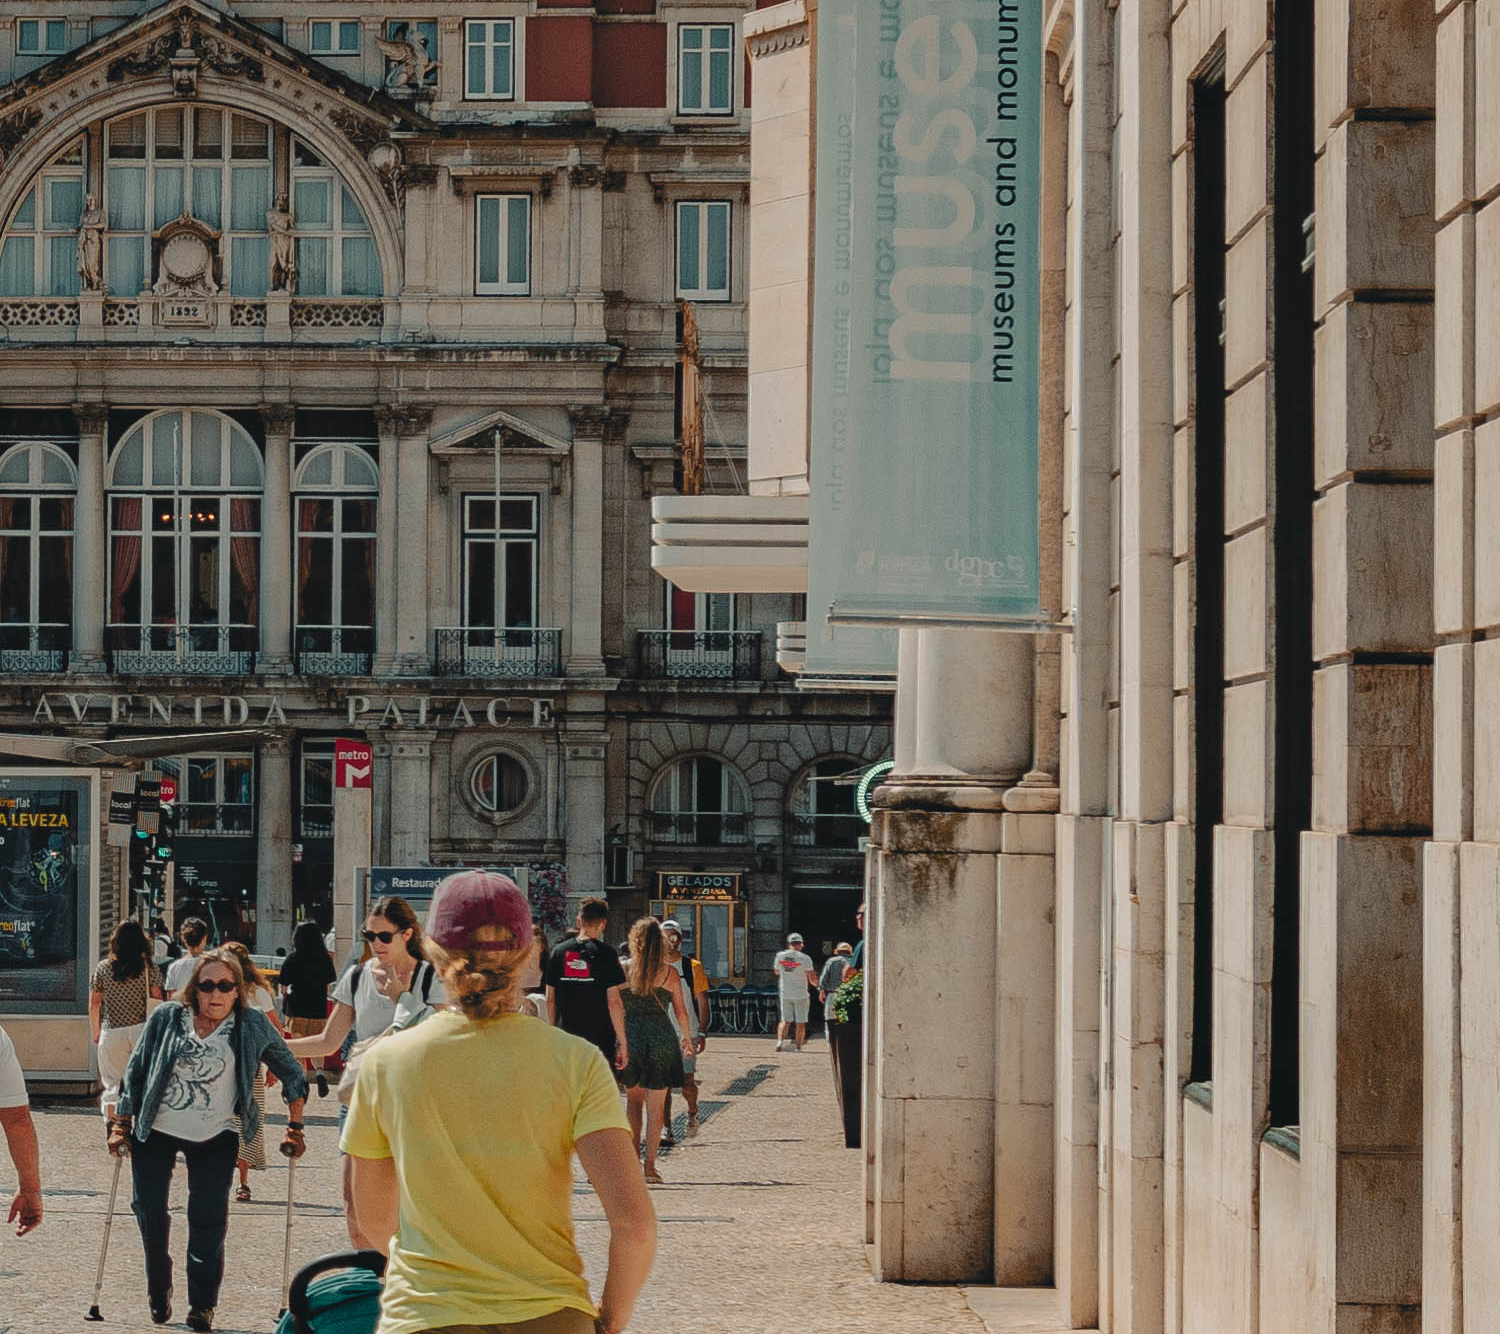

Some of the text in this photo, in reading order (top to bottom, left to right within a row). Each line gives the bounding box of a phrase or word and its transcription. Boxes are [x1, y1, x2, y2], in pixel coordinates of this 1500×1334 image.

[986, 136, 1018, 208] and
[991, 221, 1017, 384] museums
[32, 692, 289, 727] AVENIDA
[345, 695, 557, 729] PALACE
[338, 750, 369, 761] metro
[140, 789, 160, 797] local
[160, 786, 174, 795] tro
[111, 800, 132, 809] local
[11, 813, 69, 828] LEVEZA
[391, 877, 442, 888] Restaurad
[667, 875, 732, 887] GELADOS
